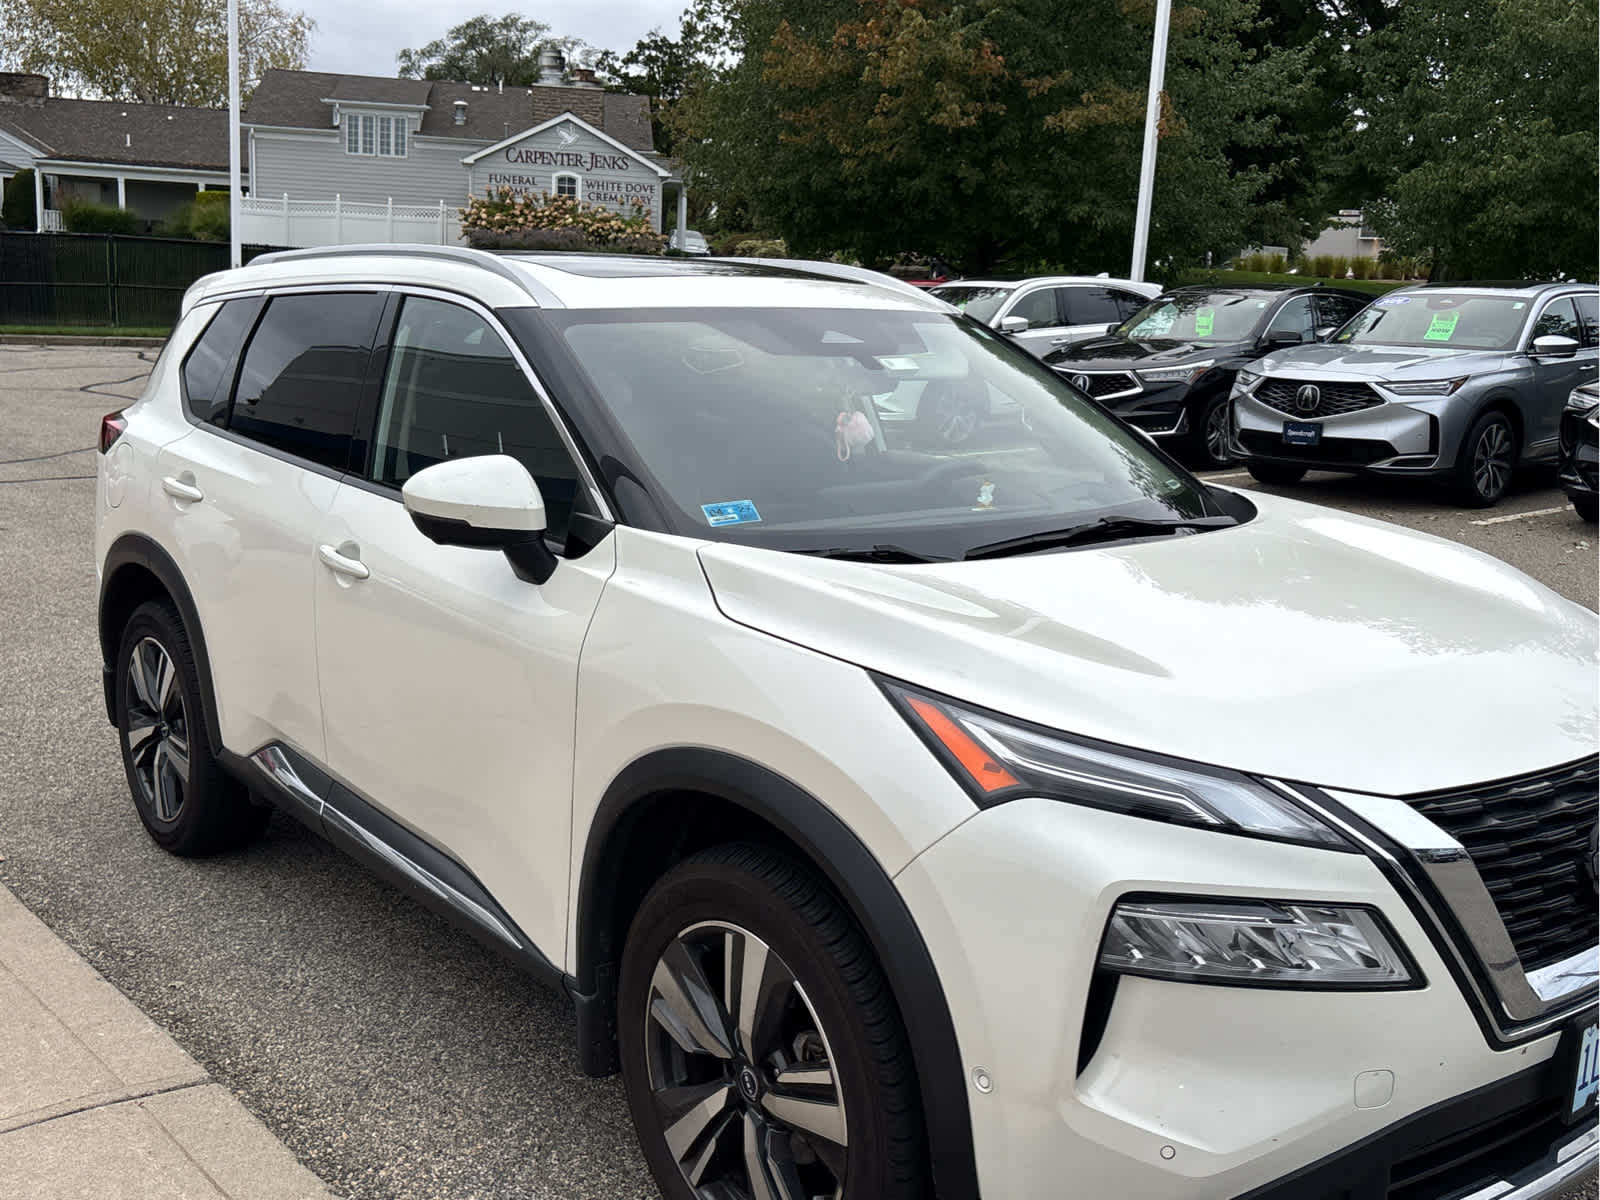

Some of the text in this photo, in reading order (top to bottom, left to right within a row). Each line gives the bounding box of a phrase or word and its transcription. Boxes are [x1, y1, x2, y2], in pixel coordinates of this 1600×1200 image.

[505, 147, 629, 171] CARPENTER-JENKS
[488, 174, 537, 185] FUNERAL
[586, 180, 656, 194] WHITE DOVE
